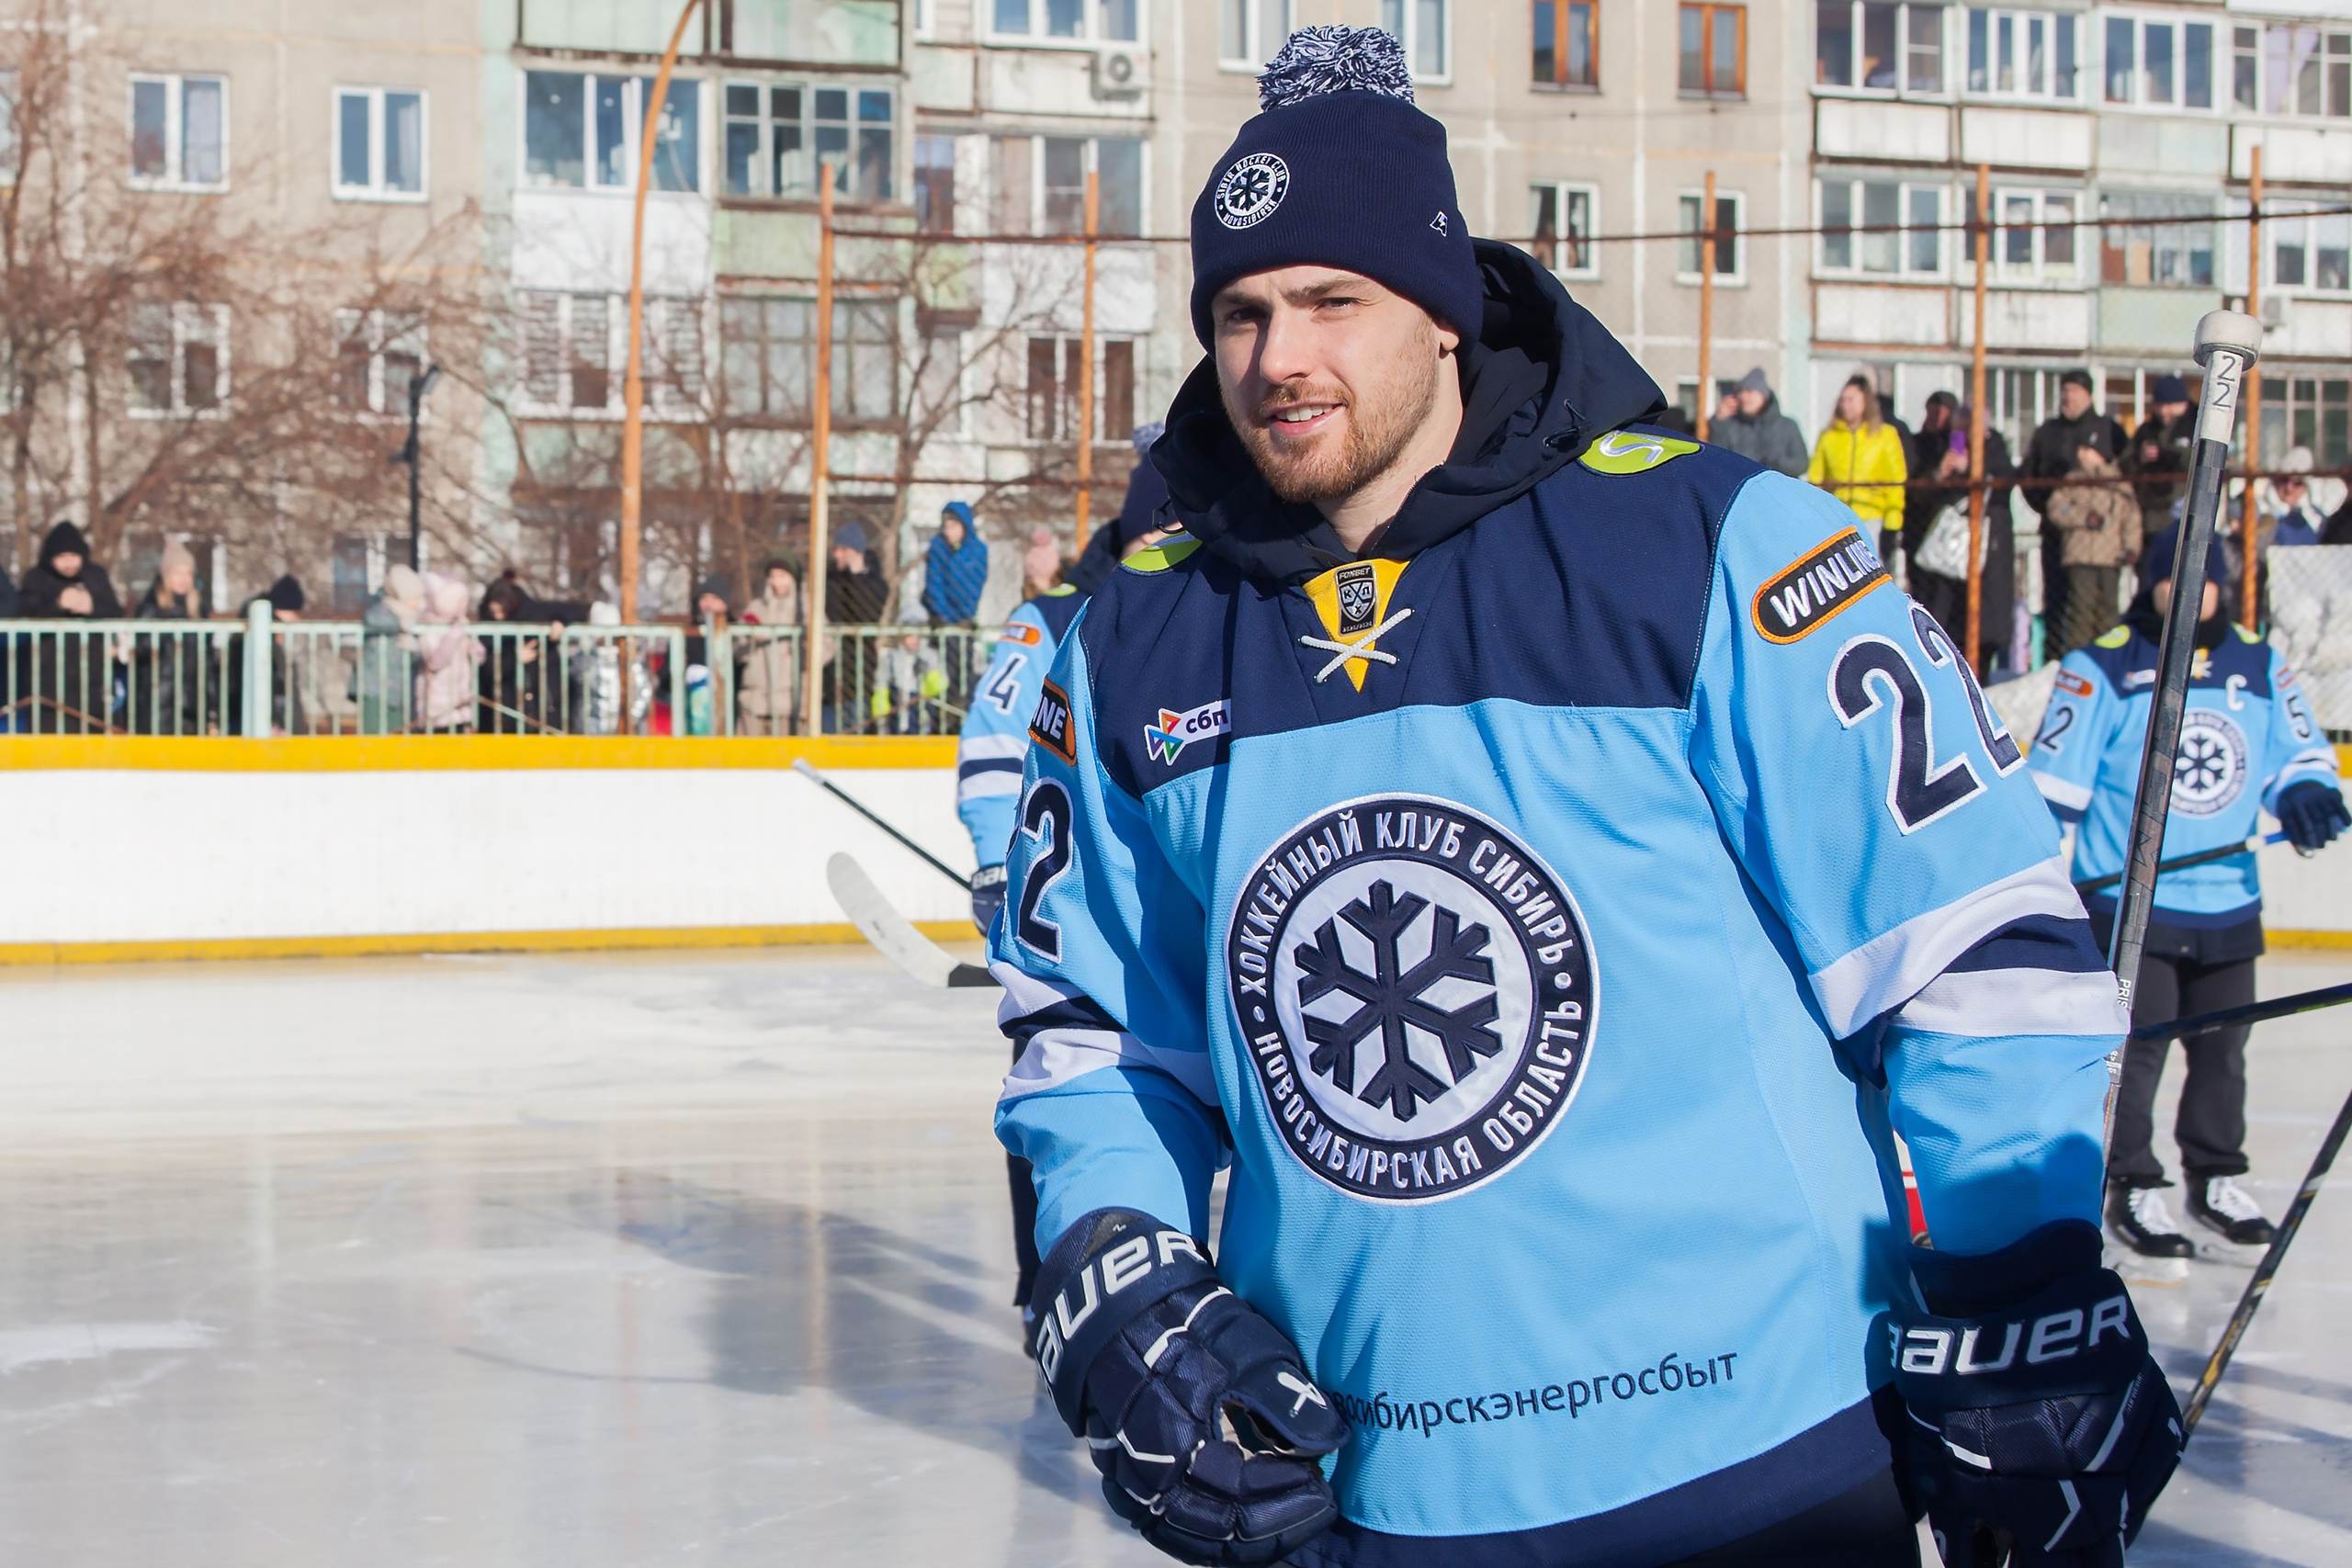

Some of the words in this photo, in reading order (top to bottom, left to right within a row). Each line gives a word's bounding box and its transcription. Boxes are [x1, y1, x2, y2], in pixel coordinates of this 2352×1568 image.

[1216, 171, 1235, 199] SIBIR
[1235, 155, 1272, 172] HOCKEY
[1271, 161, 1287, 182] CLUB
[1223, 198, 1277, 226] NOVOSIBIRSK
[1339, 567, 1371, 580] FONBET
[984, 653, 1028, 715] 4
[2225, 673, 2248, 712] C
[1185, 708, 1228, 733] сбп
[1826, 597, 2028, 836] 22
[2032, 702, 2078, 755] 2
[1005, 776, 1073, 964] 2
[1240, 809, 1363, 995] ХОККЕЙНЫЙ
[1375, 811, 1465, 858] КЛУБ
[1470, 839, 1575, 966] СИБИРЬ
[1254, 1029, 1484, 1190] НОВОСИБИРСКАЯ
[1481, 1001, 1584, 1153] ОБЛАСТЬ
[1332, 1352, 1738, 1438] восибирскэнергосбыт
